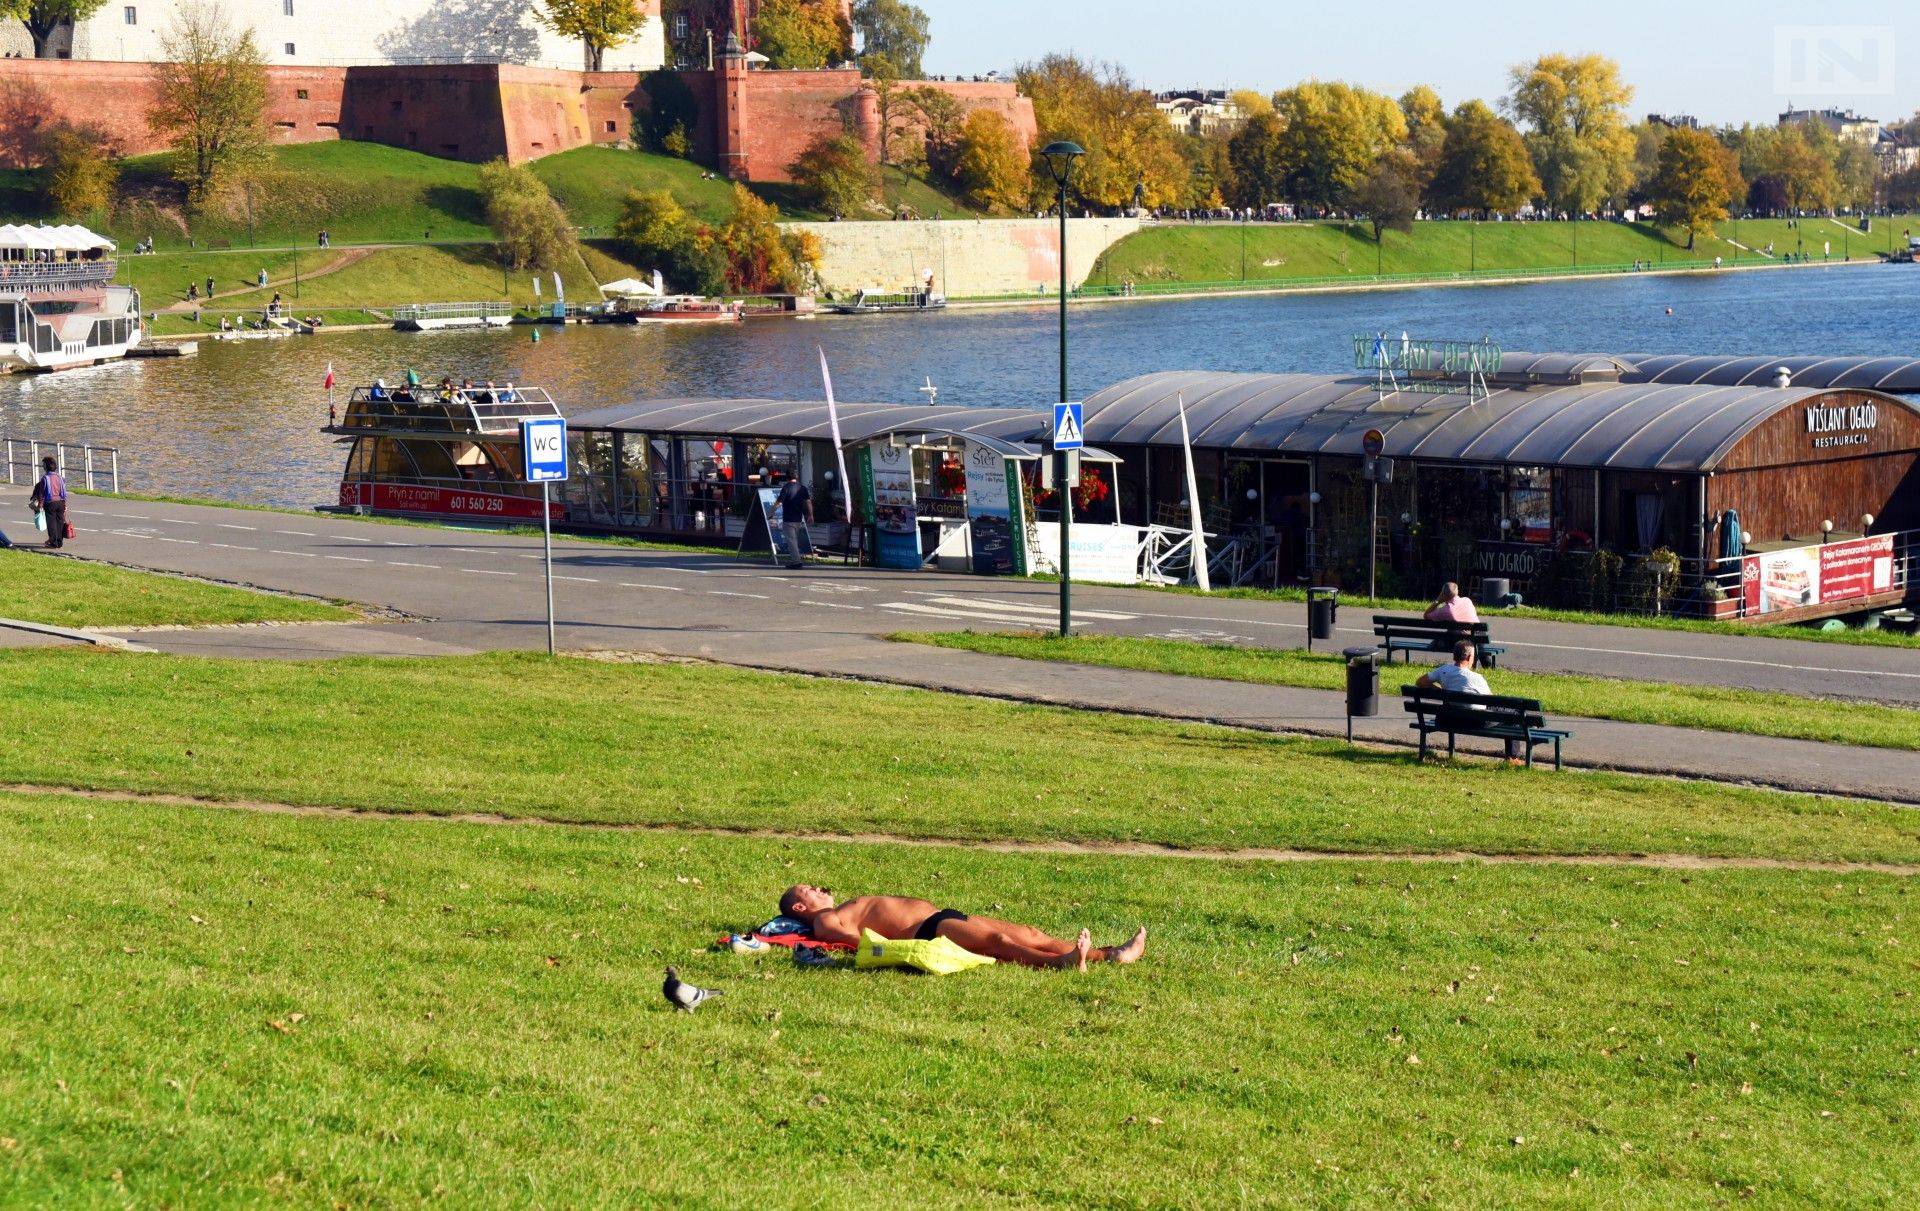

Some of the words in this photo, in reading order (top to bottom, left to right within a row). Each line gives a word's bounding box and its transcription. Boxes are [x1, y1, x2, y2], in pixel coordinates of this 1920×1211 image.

[1807, 402, 1846, 433] WIŚLANY
[1849, 399, 1877, 430] OGRÓD
[534, 436, 558, 451] WC
[1815, 433, 1868, 448] RESTAURACJA
[450, 497, 466, 509] 601
[468, 498, 484, 510] 560
[486, 499, 503, 511] 250
[1070, 542, 1105, 552] RUISES
[1498, 550, 1534, 574] OGRÓD
